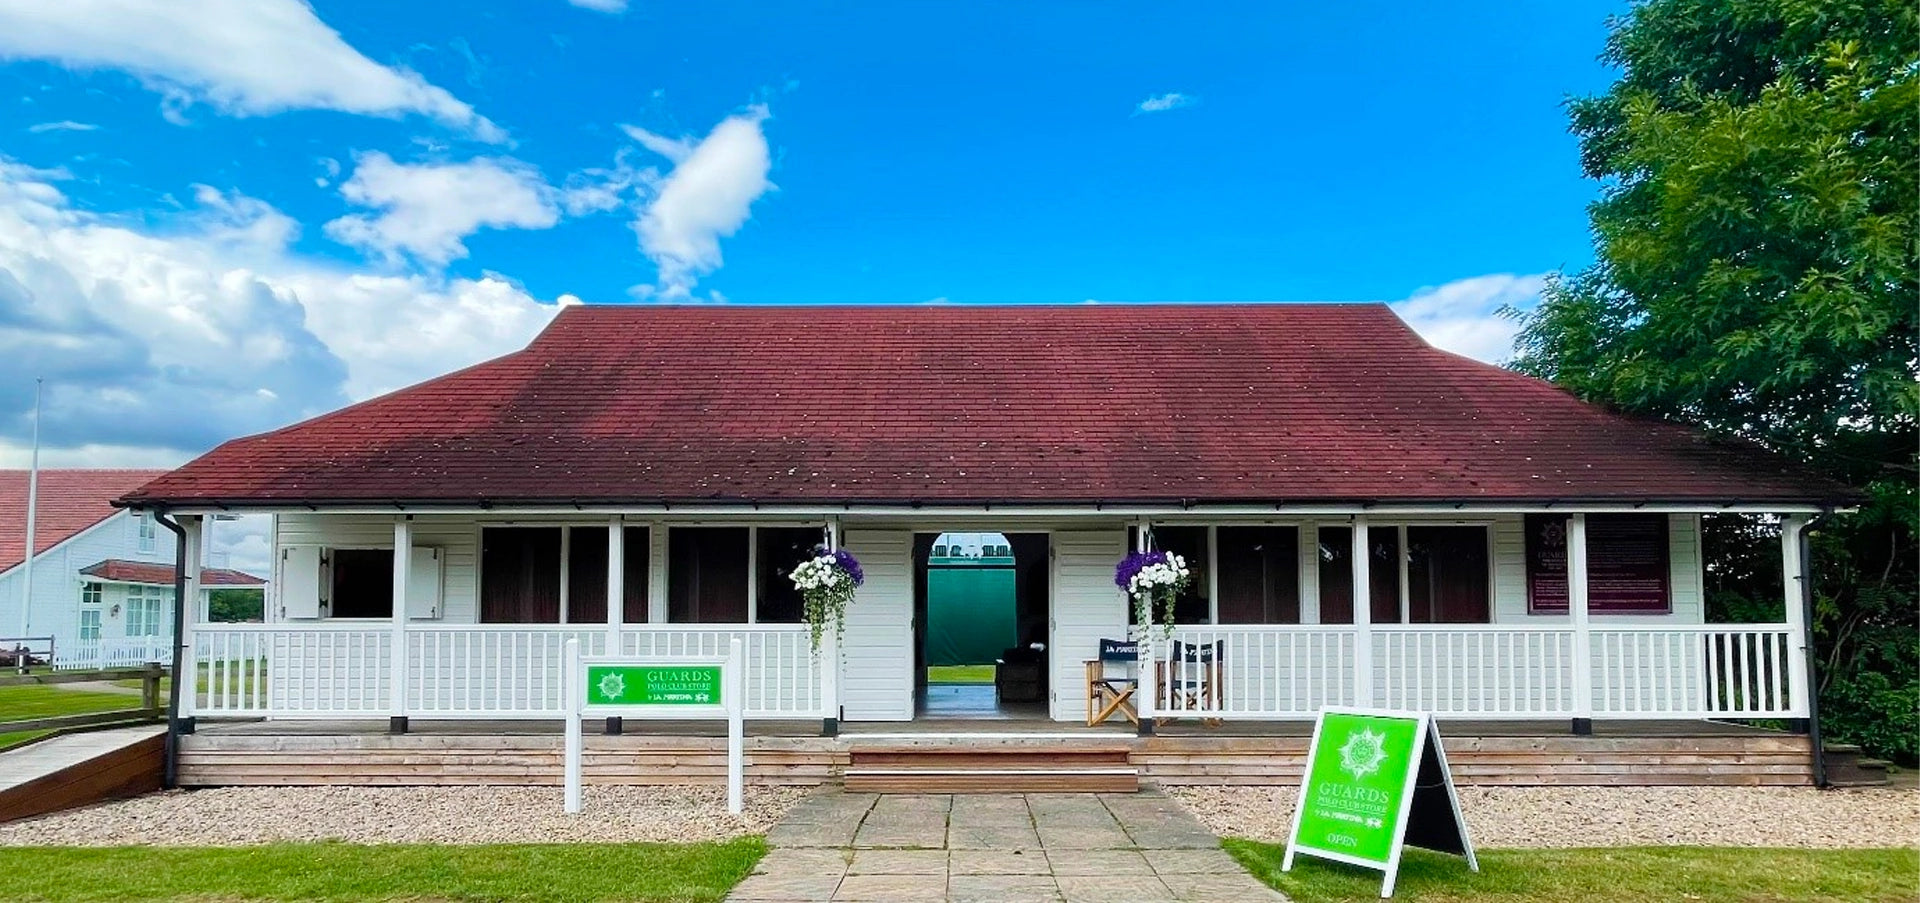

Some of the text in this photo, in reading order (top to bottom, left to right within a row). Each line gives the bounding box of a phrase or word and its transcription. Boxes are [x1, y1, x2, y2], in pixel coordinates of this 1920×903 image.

[647, 671, 711, 682] GUARDS
[647, 682, 711, 690] POLO CLUB STORE
[1319, 782, 1389, 804] GUARDS
[1317, 796, 1387, 813] POLO CLUB STORE
[1327, 833, 1358, 847] OPEN
